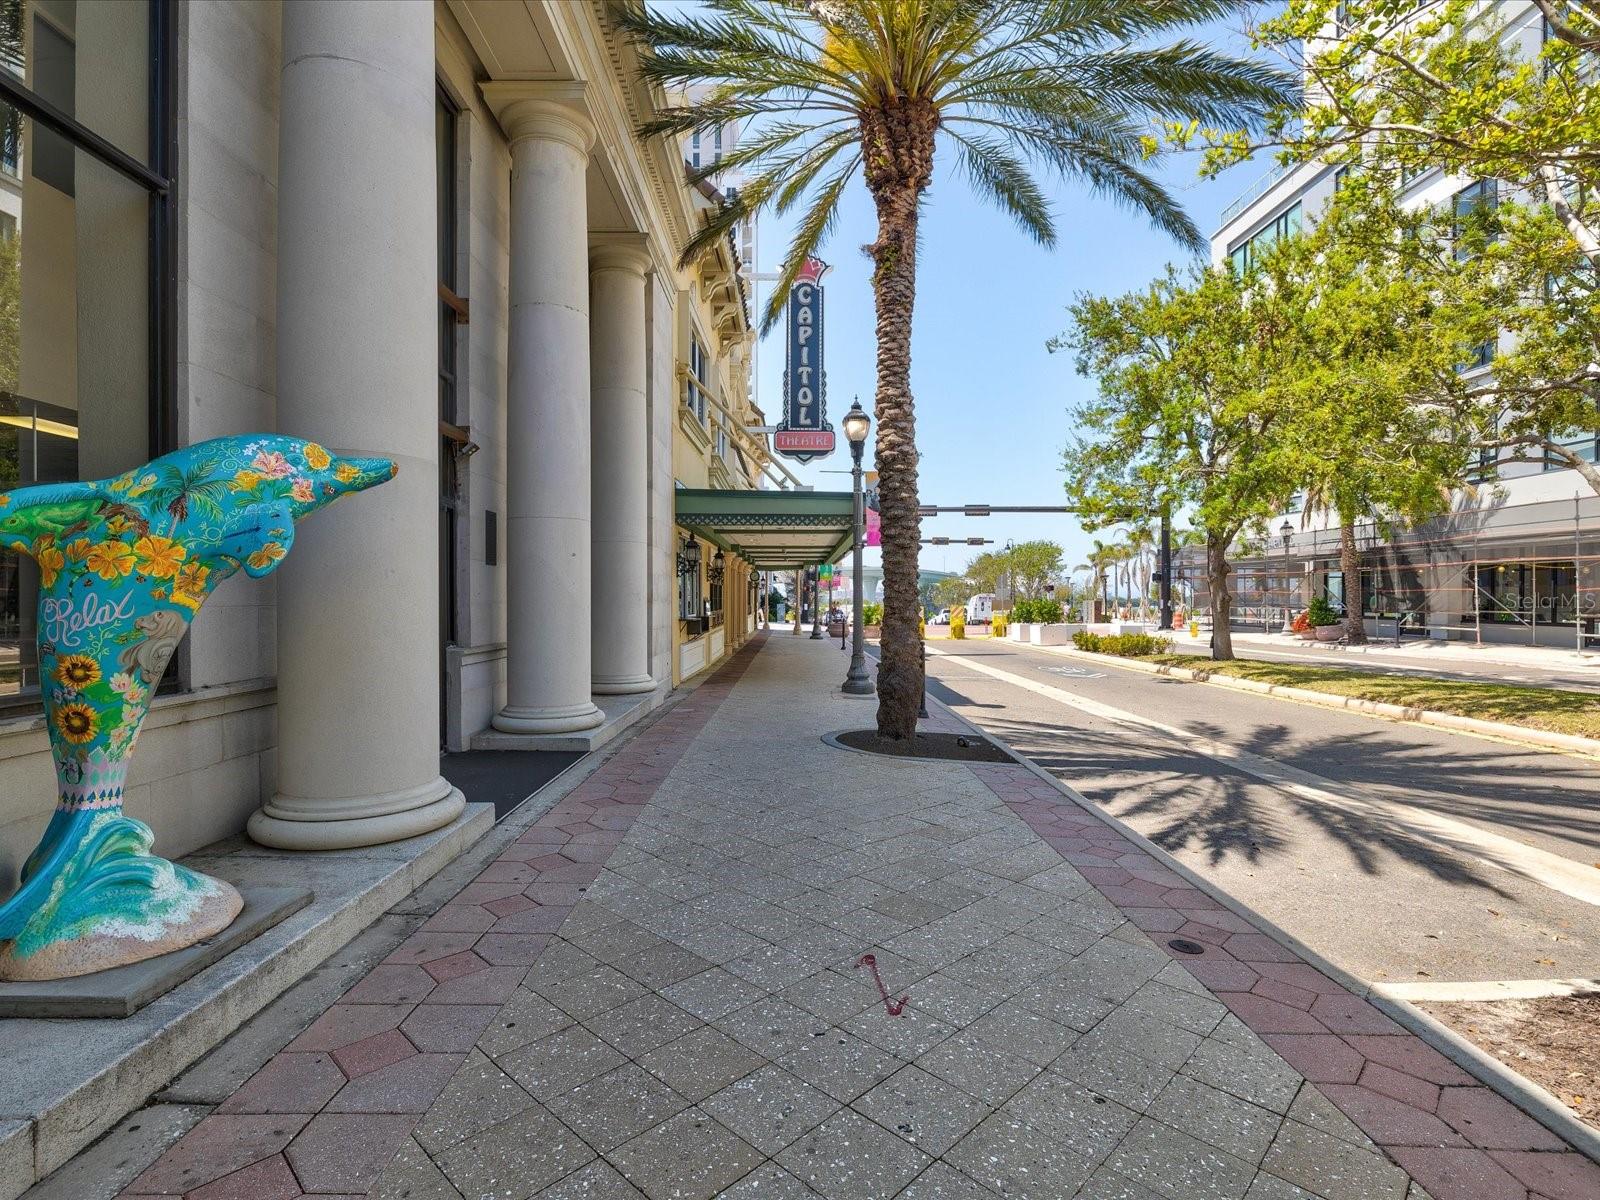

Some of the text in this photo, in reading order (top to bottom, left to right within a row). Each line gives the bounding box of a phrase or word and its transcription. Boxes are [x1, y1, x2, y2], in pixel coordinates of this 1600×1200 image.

[796, 286, 814, 427] CAPITOL
[780, 435, 833, 447] THEATRE
[41, 588, 135, 647] Relax
